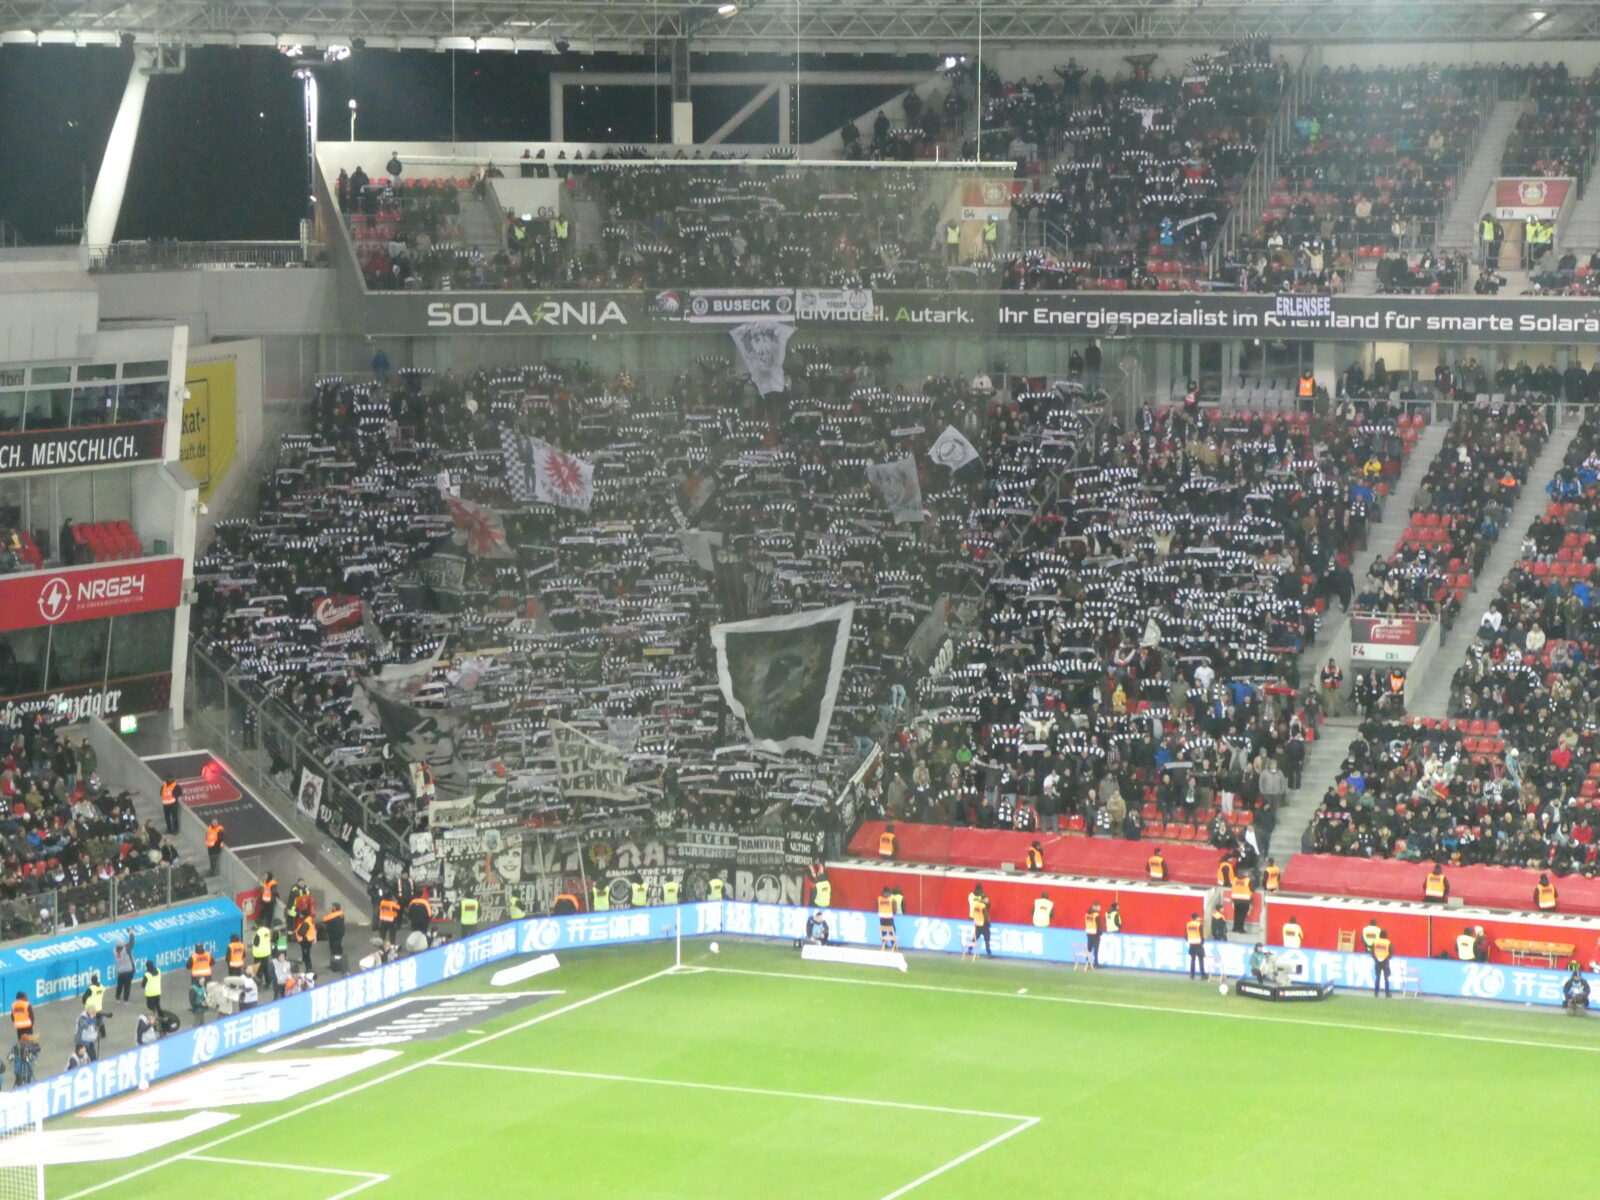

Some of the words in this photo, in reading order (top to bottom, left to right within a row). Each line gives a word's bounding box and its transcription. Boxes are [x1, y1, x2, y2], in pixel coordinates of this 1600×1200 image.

[427, 301, 628, 327] SOLARNIA
[713, 299, 771, 312] BUSECK
[895, 306, 975, 324] Autark.
[1276, 297, 1331, 317] ERLENSEE
[999, 307, 1028, 323] Ihr
[1033, 308, 1228, 328] Energiespezialist
[1233, 310, 1258, 326] im
[1385, 311, 1421, 330] für
[1426, 315, 1513, 331] smarte
[31, 435, 139, 466] MENSCHLICH.
[77, 574, 145, 601] NRG24
[1352, 645, 1365, 656] F4
[566, 913, 650, 943] 开云体育
[16, 935, 99, 962] Barmenia
[223, 1007, 280, 1049] 开云体育
